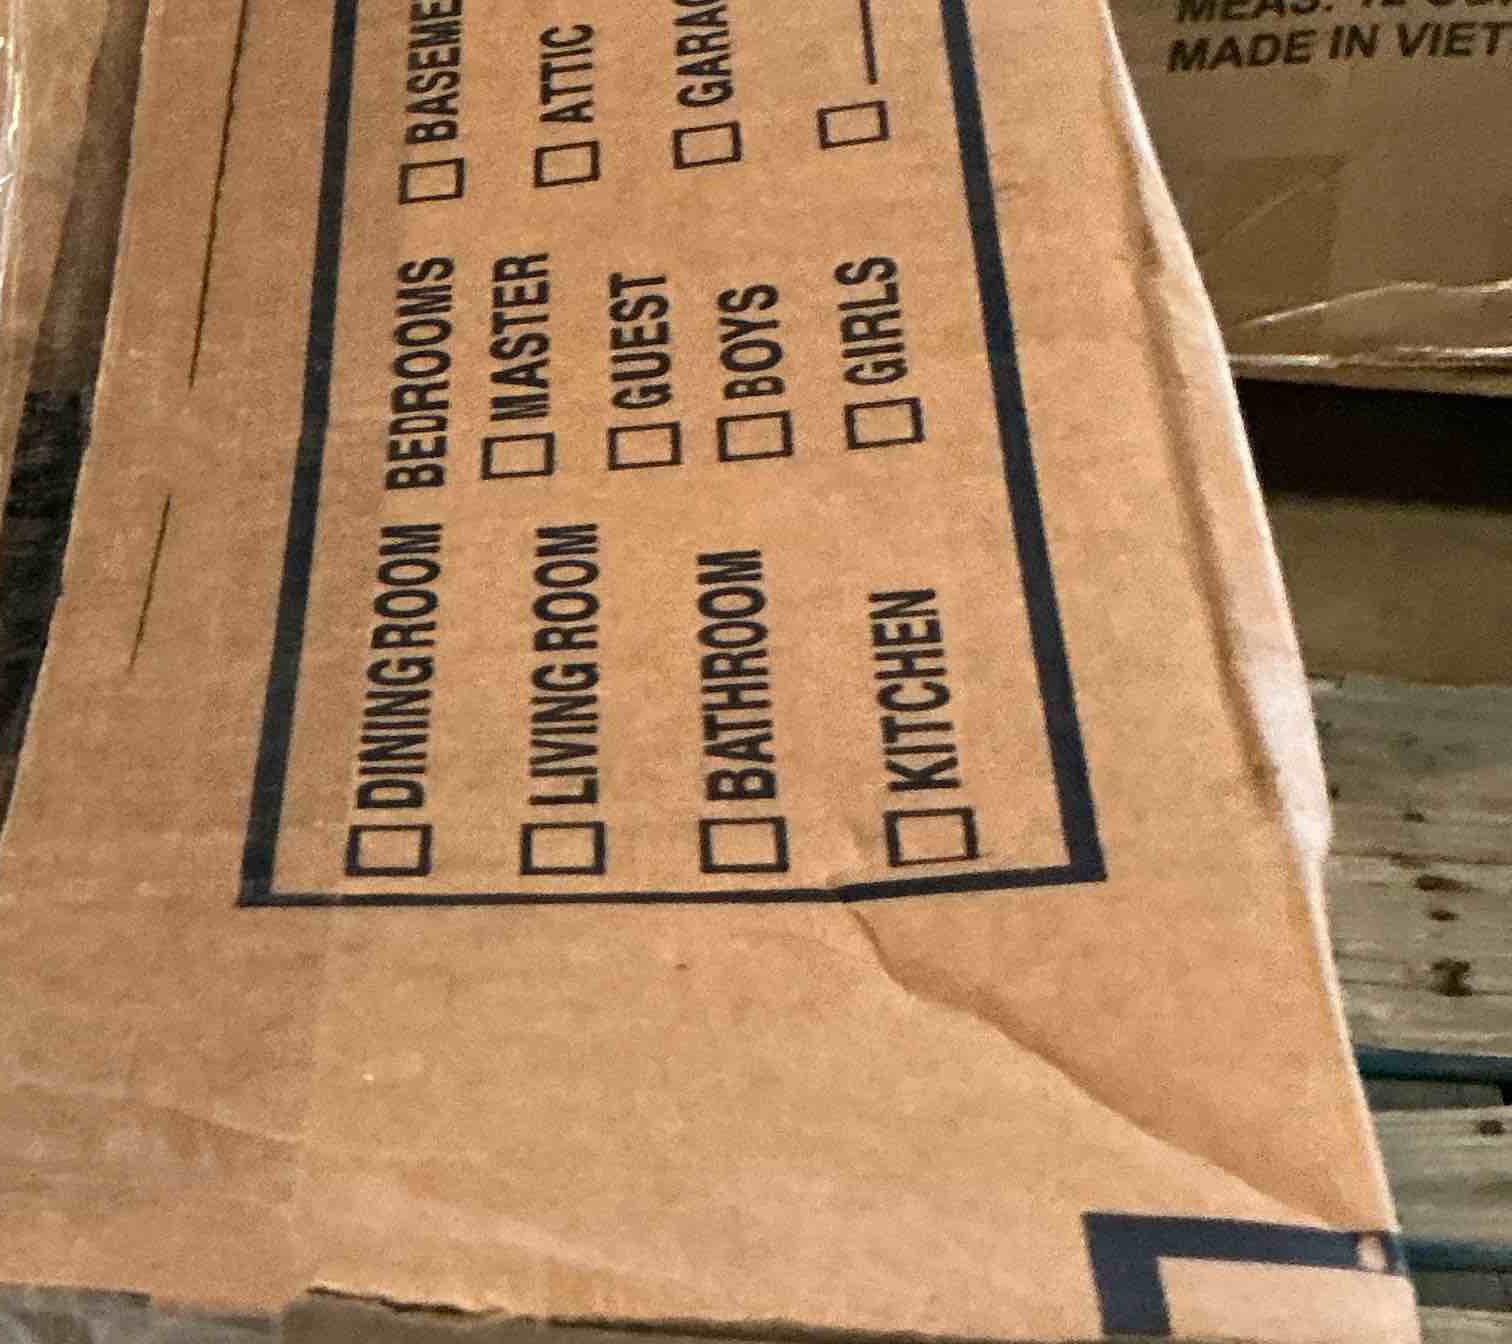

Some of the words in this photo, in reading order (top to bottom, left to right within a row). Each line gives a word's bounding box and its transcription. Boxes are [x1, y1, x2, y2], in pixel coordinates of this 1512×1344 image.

[539, 23, 594, 124] ATTIC
[1167, 28, 1317, 74] MADE
[1328, 22, 1381, 60] IN
[1396, 20, 1512, 58] VIET
[385, 256, 454, 490] BEDROOMS
[489, 252, 551, 422] MASTER
[608, 272, 673, 410] GUEST
[717, 283, 786, 399] BOYS
[834, 256, 905, 386] GIRLS
[697, 548, 776, 802] BATHROOM
[869, 588, 962, 793] KITCHEN
